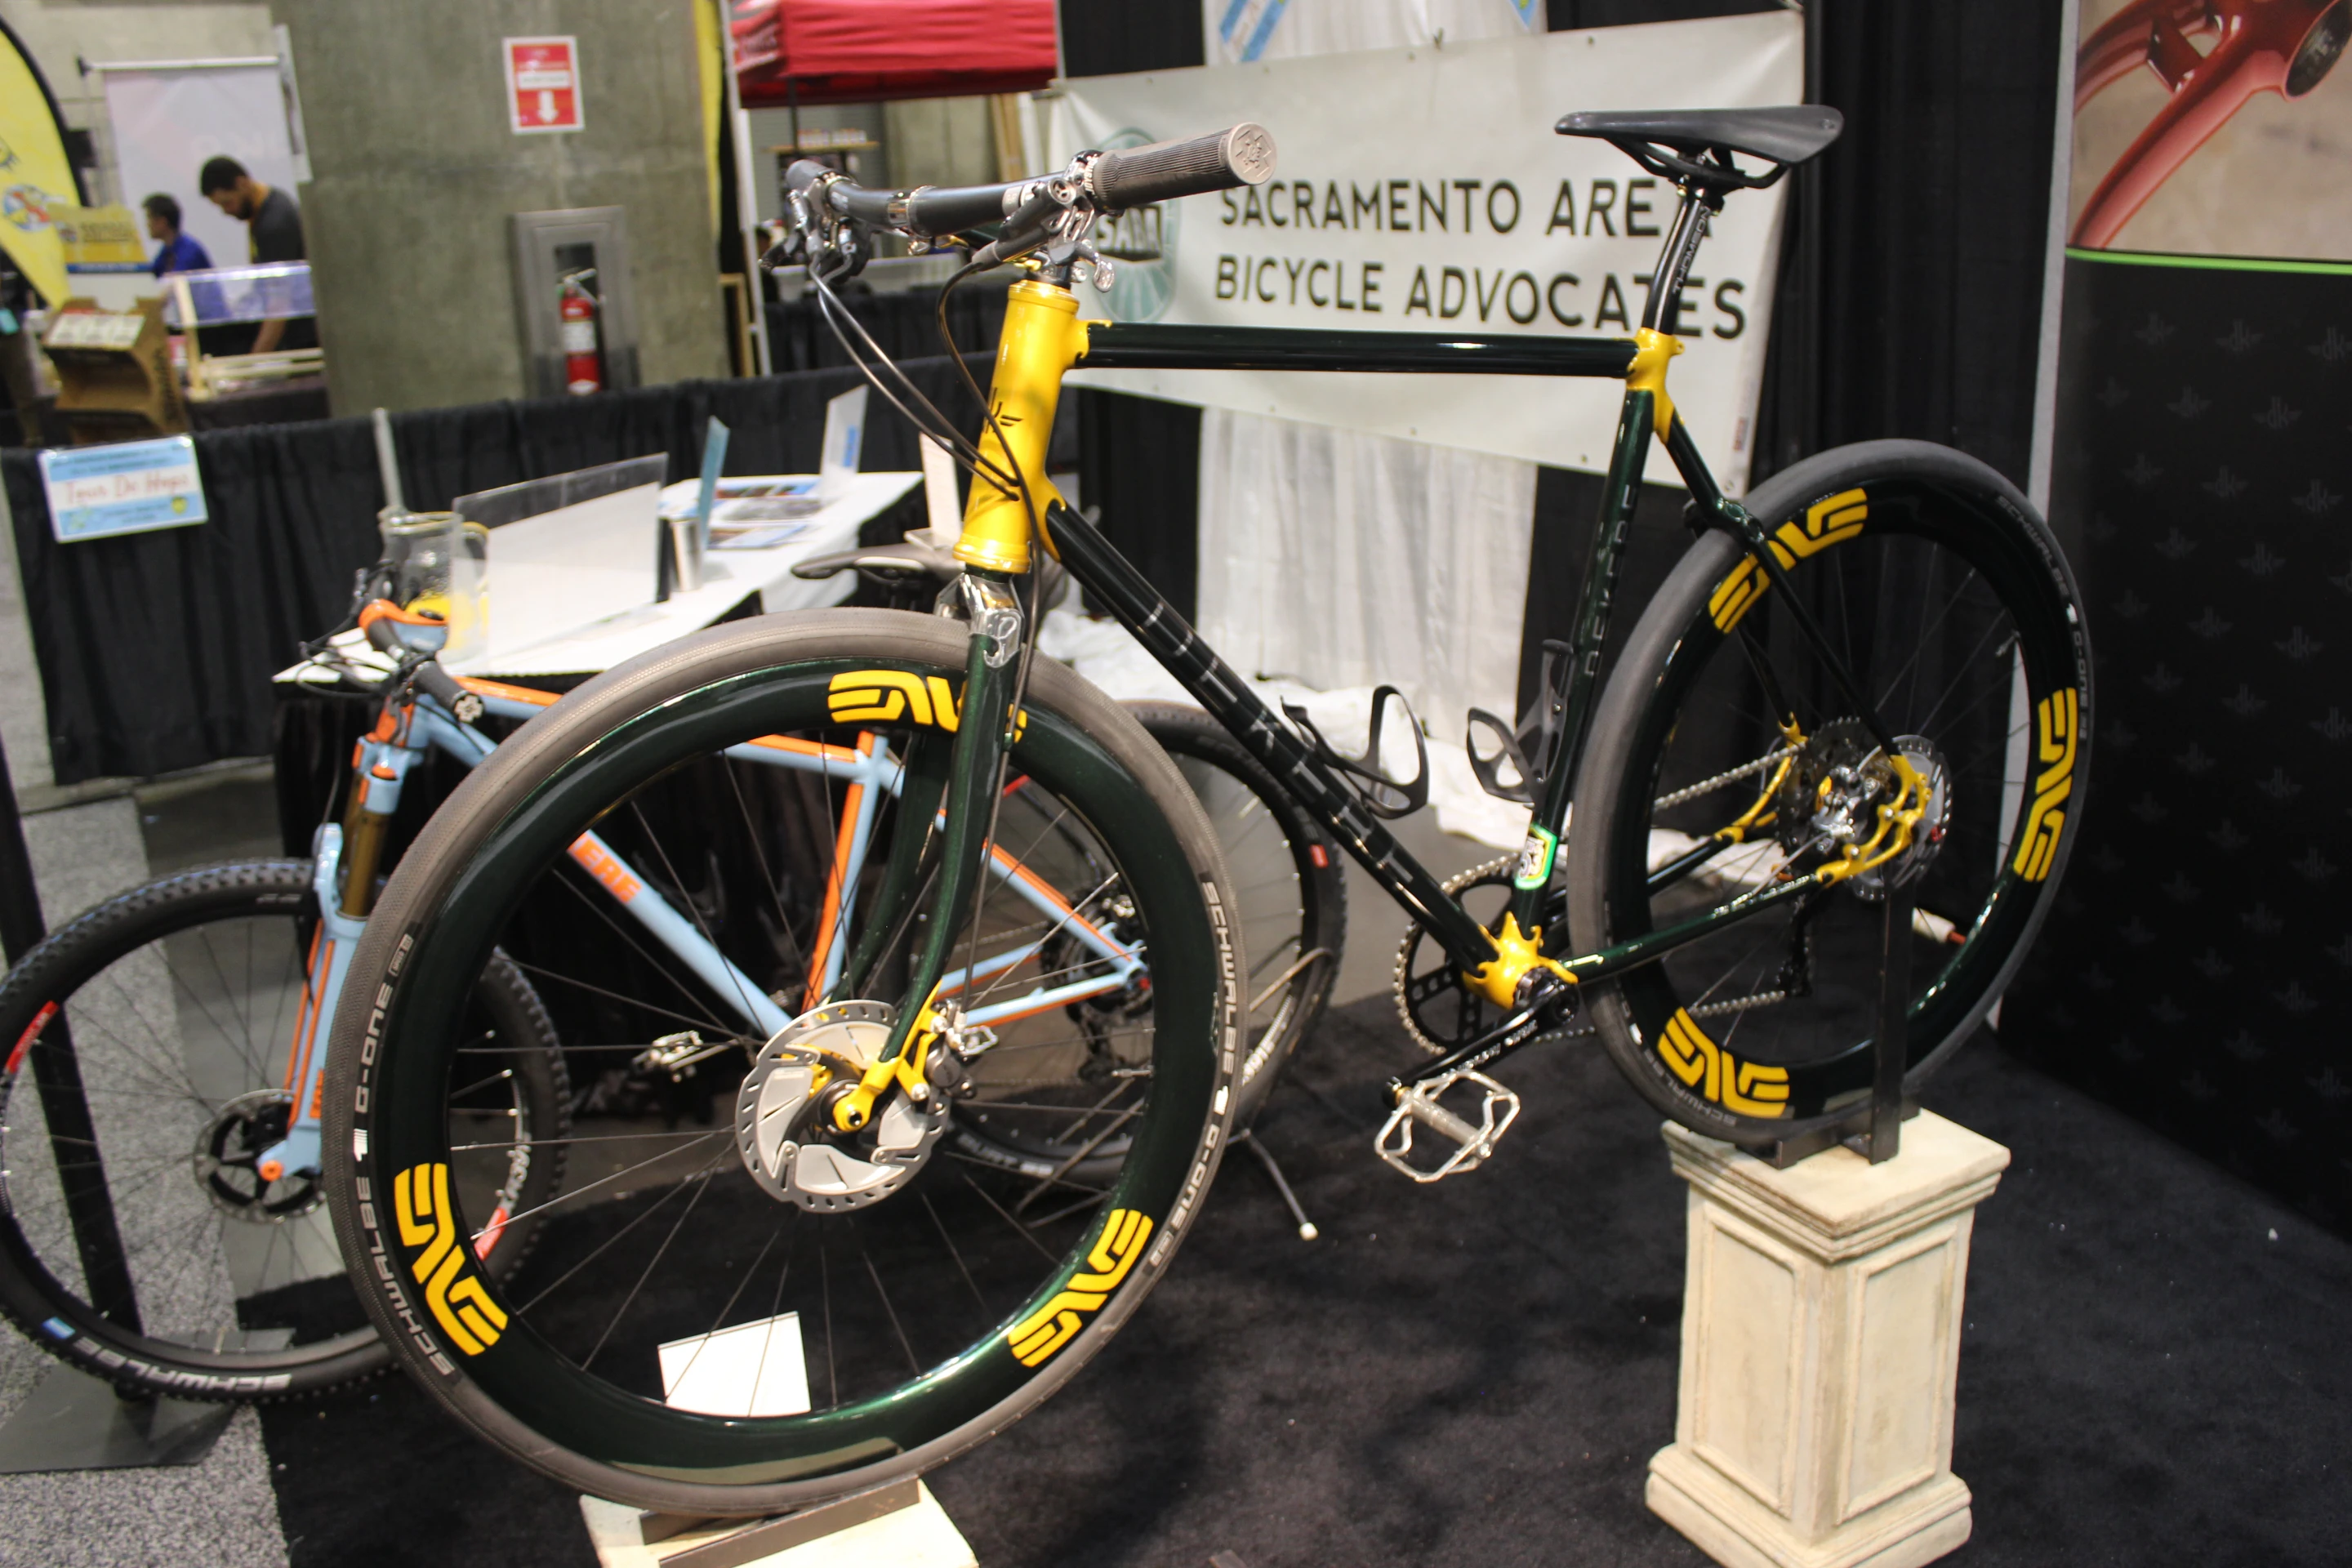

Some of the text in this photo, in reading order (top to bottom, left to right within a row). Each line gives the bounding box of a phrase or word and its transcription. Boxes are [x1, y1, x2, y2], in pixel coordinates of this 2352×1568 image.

[1221, 179, 1713, 237] SACRAMENTO ARE
[1673, 205, 1712, 294] THOMSON
[1216, 255, 1384, 313] BICYCLE
[1995, 495, 2070, 597] SCHWALBE
[1202, 881, 1237, 1075] SCHWALBE
[354, 982, 394, 1114] G-ONE
[1643, 1049, 1738, 1127] SCHWALBE
[1171, 1123, 1220, 1230] G-ONE
[355, 1176, 456, 1376] SCHWALBE
[74, 1336, 292, 1392] SCHWALBE
